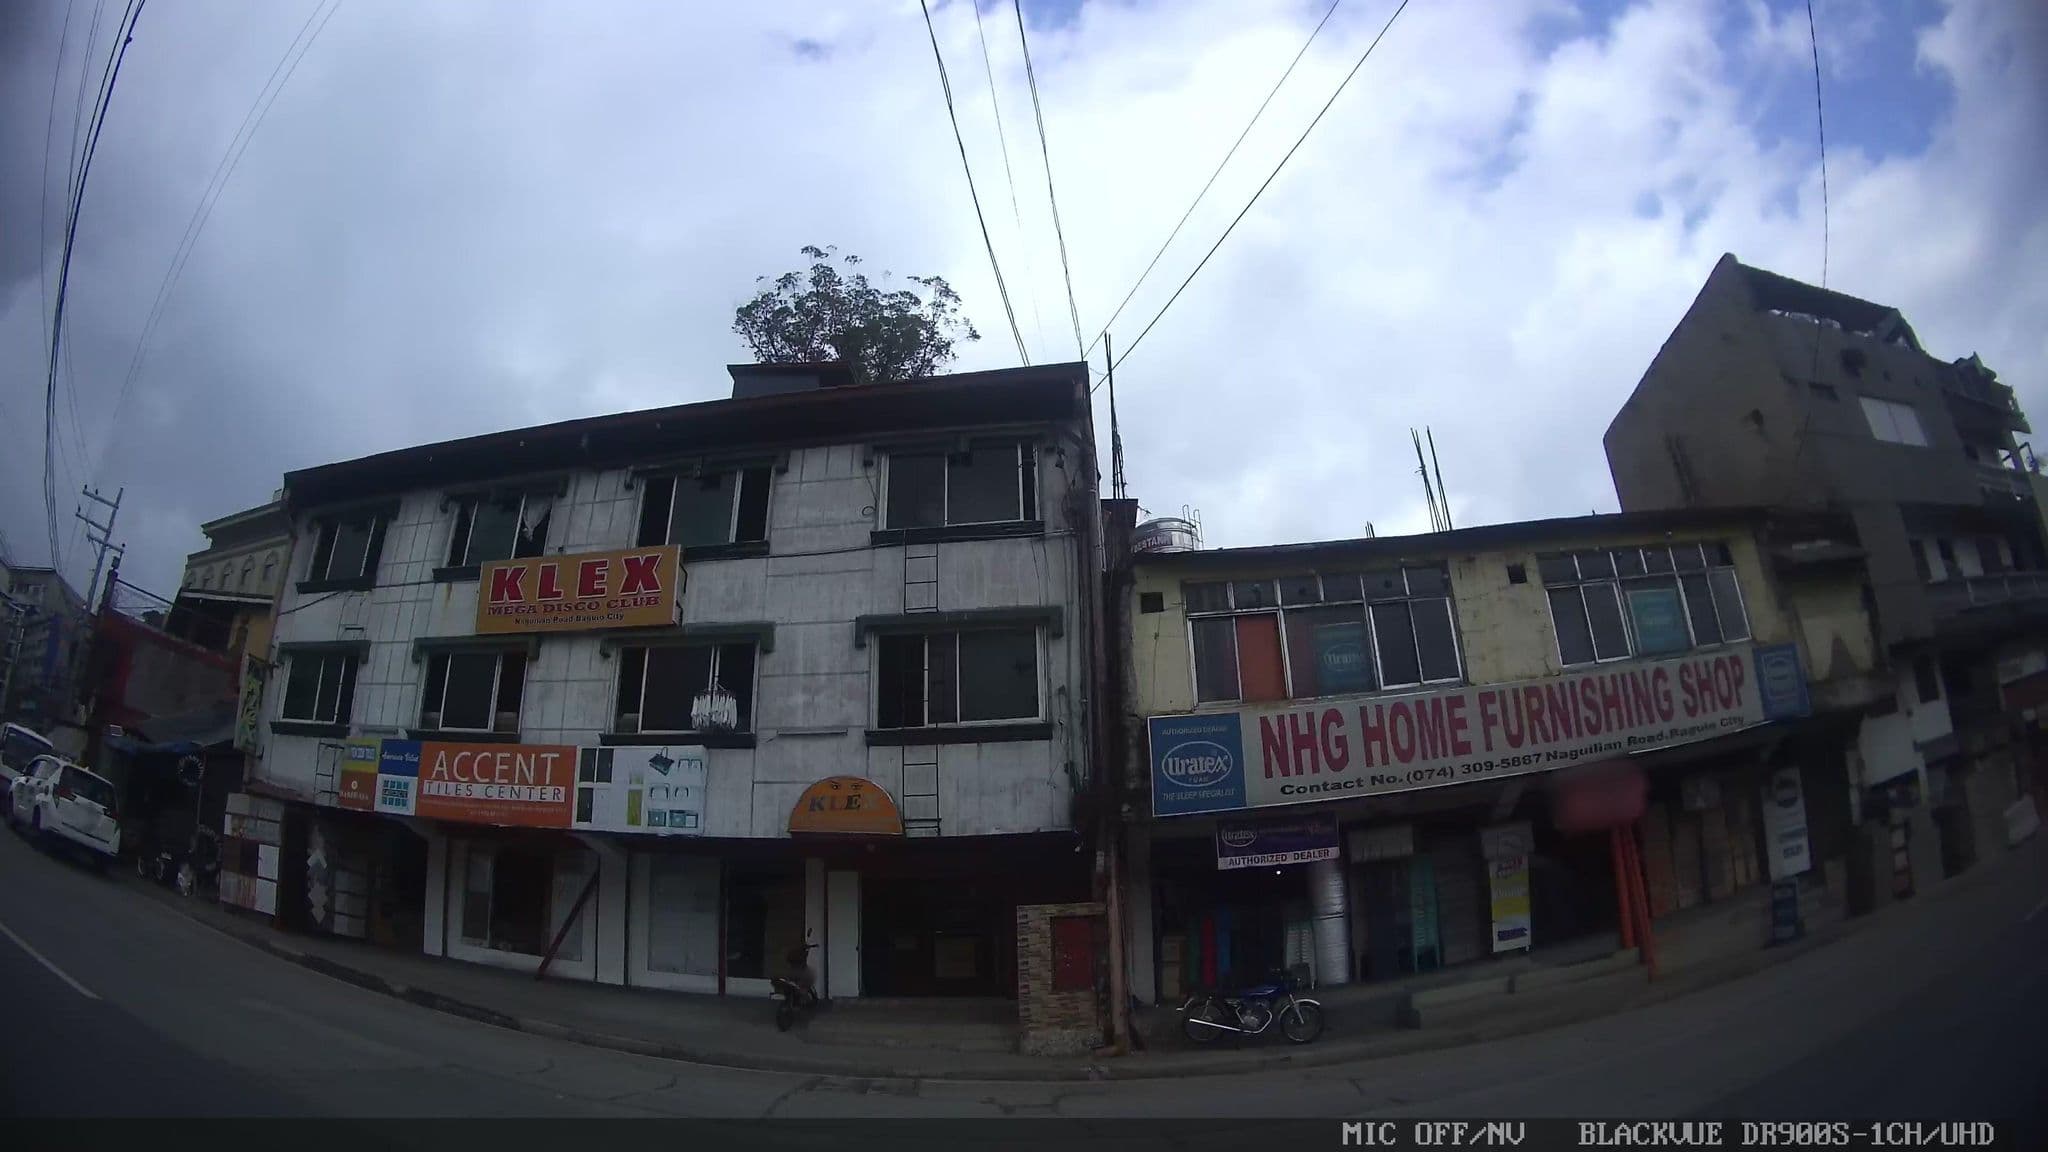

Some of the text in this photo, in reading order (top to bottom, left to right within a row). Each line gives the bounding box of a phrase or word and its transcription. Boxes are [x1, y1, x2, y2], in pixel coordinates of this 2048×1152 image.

[489, 553, 662, 604] KLEX
[488, 596, 660, 615] MEGA DISCO CLUB
[607, 612, 624, 622] City
[1259, 708, 1350, 779] NHG
[1359, 695, 1472, 768] HOME
[1478, 667, 1675, 752] FURNISHING
[1678, 655, 1745, 718] SHOP
[430, 750, 560, 785] ACCENT
[1280, 776, 1364, 796] Contact
[1461, 753, 1541, 774] 309-5887
[1546, 739, 1622, 762] Naguilian
[425, 780, 473, 797] TILES
[484, 785, 561, 801] CENTER
[1228, 849, 1330, 866] AUTHORIZED DEALER
